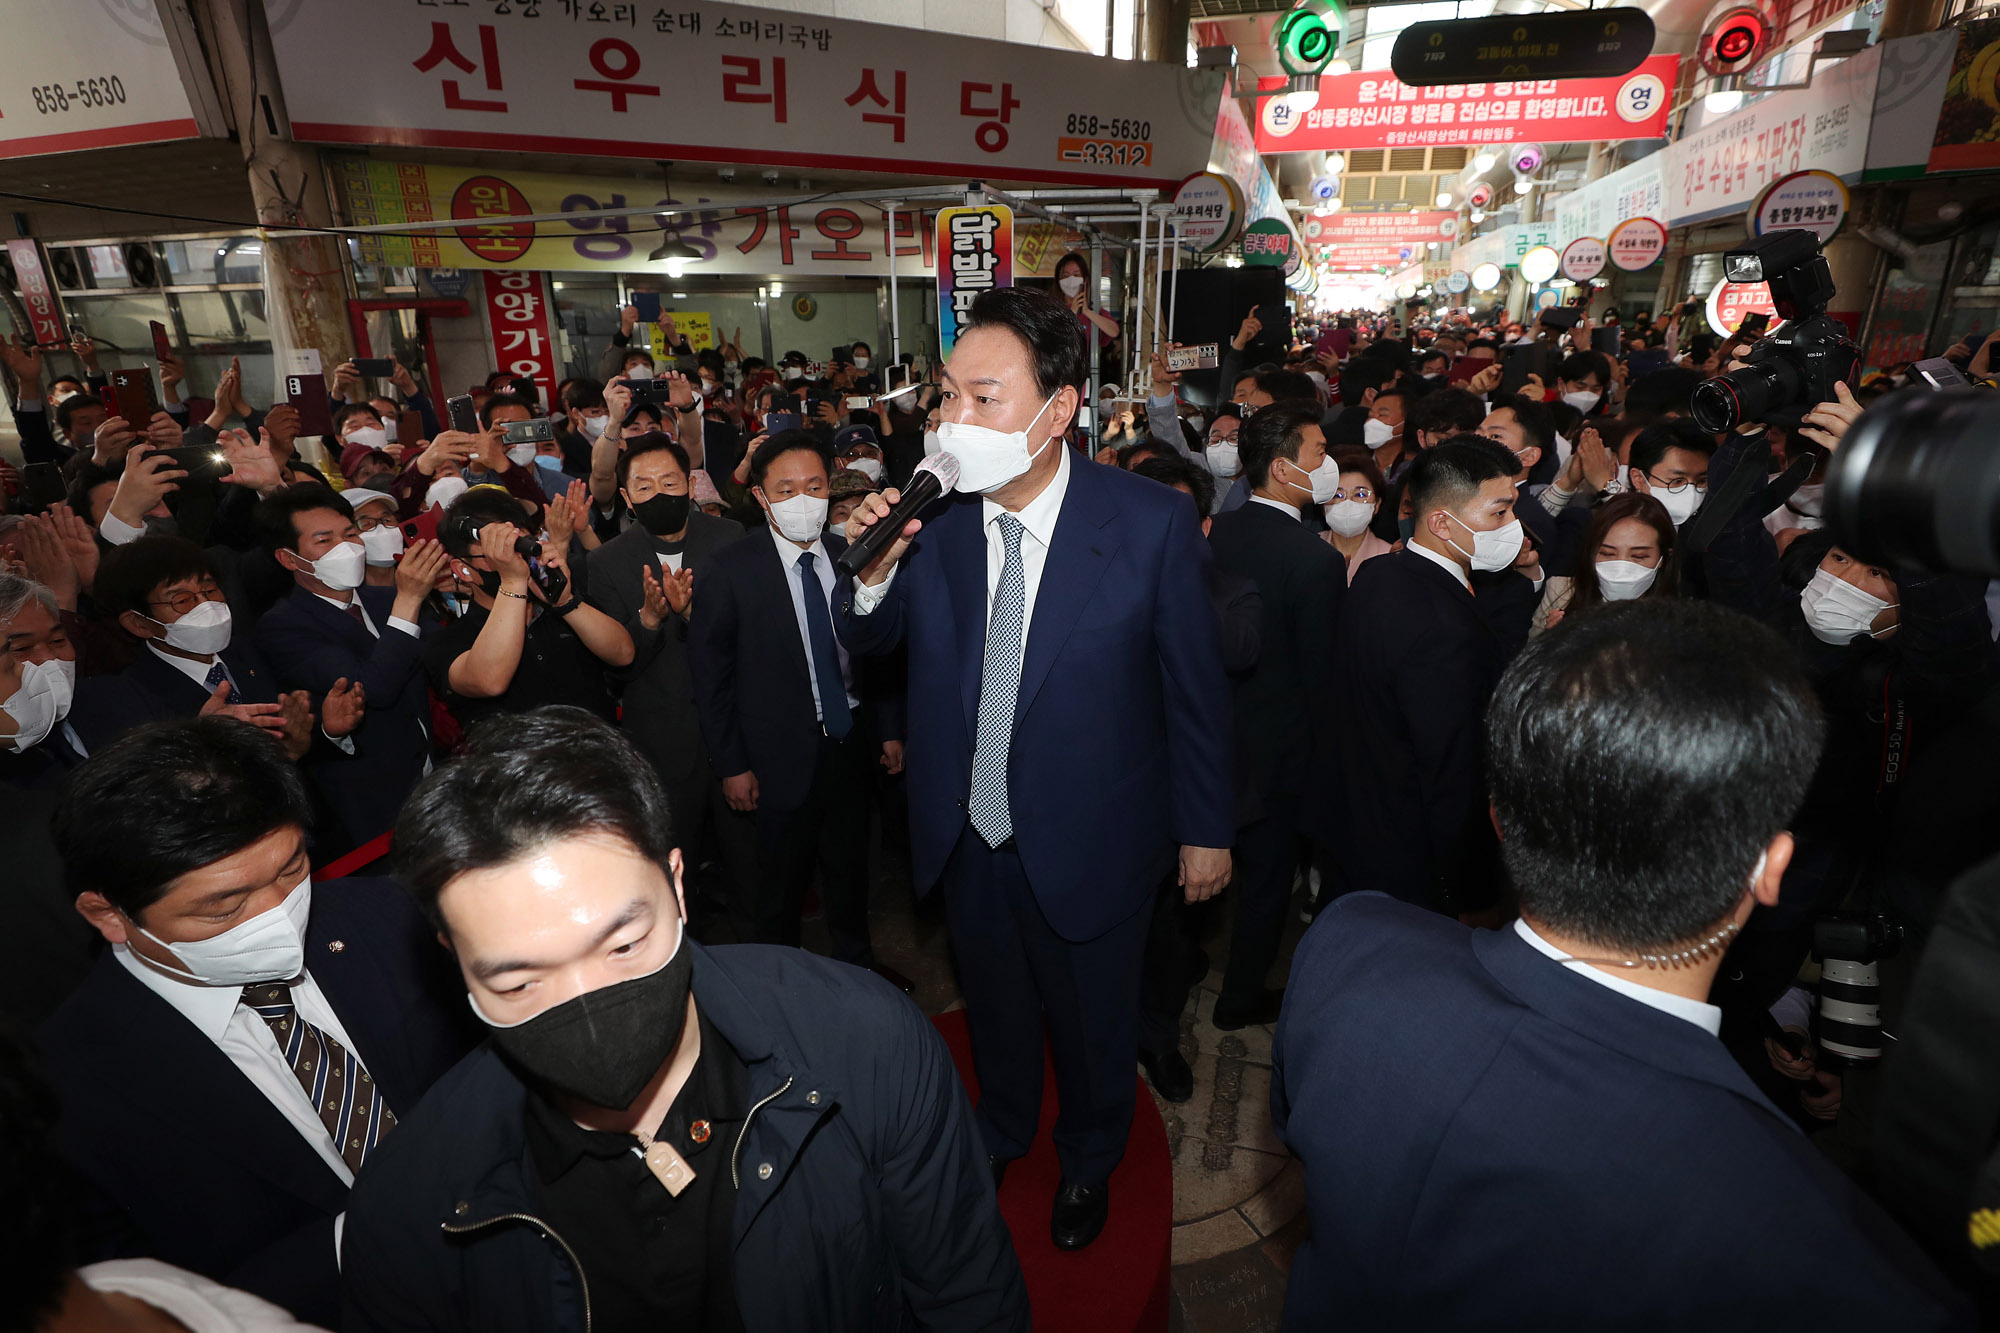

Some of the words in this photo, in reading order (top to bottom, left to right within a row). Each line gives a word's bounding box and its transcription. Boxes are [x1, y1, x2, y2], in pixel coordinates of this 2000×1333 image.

[562, 0, 637, 28] 가오리
[651, 8, 701, 35] 순대
[714, 17, 833, 51] 소머리국밥
[31, 75, 126, 114] 858-5630
[1630, 87, 1652, 111] 영
[1272, 103, 1292, 126] 환
[1307, 105, 1407, 129] 안동중앙신시장
[1411, 102, 1456, 126] 방문을
[1459, 99, 1521, 123] 진심으로
[1524, 96, 1609, 121] 환영합니다.
[1066, 113, 1151, 141] 858-5630
[1386, 129, 1469, 145] 중앙신시장상인회
[1471, 126, 1516, 141] 회원일동
[469, 185, 522, 253] 원조
[1769, 203, 1840, 224] 종합청과상회
[734, 203, 935, 268] 가오리
[1245, 233, 1290, 255] 금복야채
[951, 213, 1000, 338] 닭발편
[1725, 291, 1774, 306] 돼지고
[1774, 338, 1793, 346] Canon
[1889, 732, 1902, 749] 5D
[1886, 752, 1900, 783] EOS
